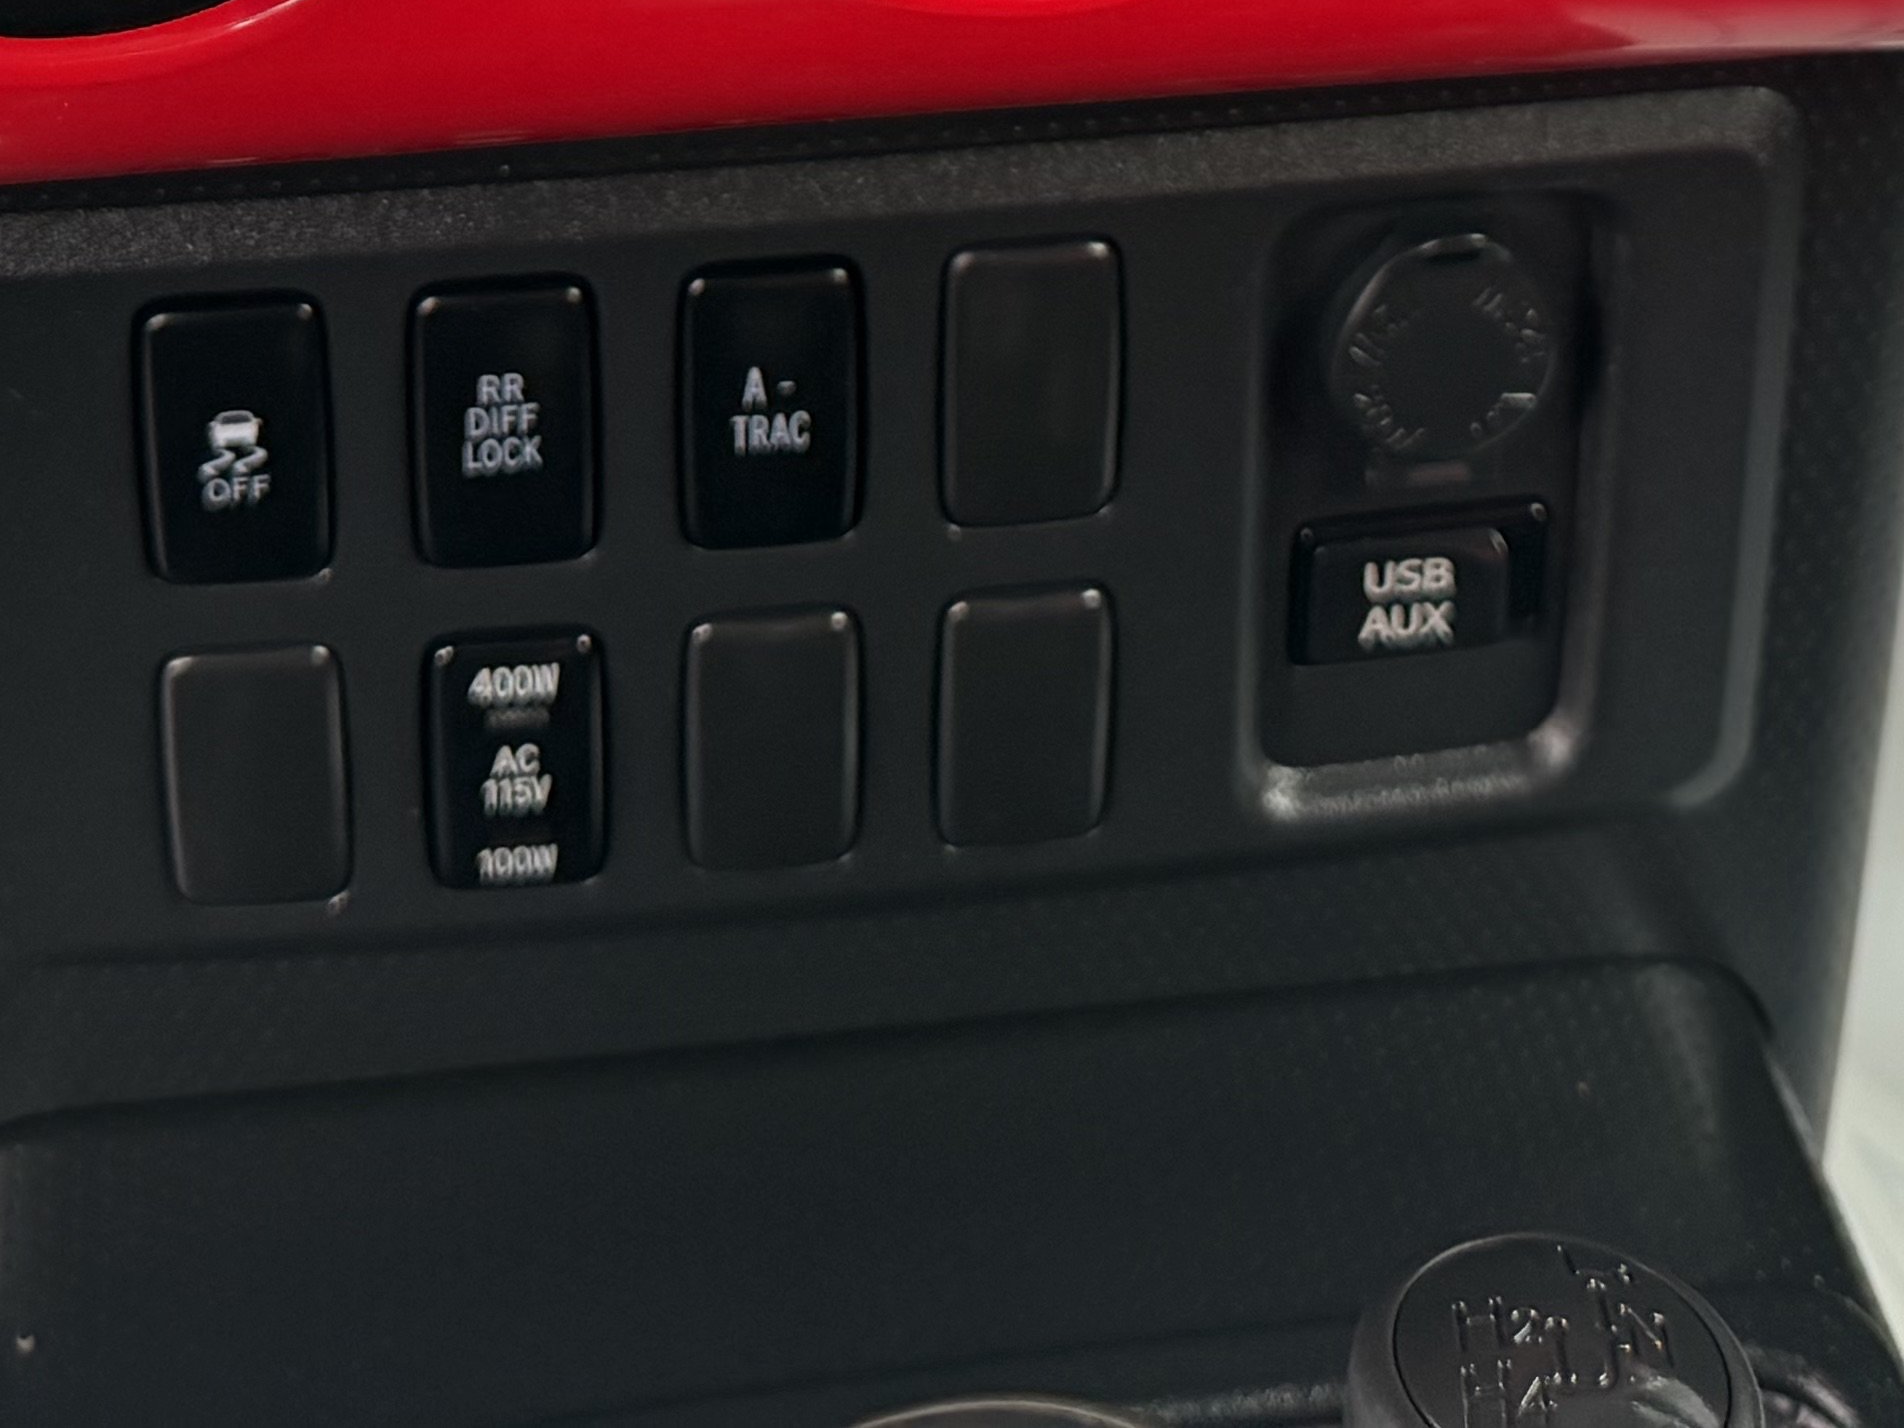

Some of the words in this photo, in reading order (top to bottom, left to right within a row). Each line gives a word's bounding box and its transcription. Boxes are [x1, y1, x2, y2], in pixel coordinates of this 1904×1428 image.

[479, 372, 525, 405] RR
[466, 402, 540, 438] DIFF
[729, 409, 812, 455] TRAC
[463, 436, 543, 475] LOCK
[201, 473, 270, 507] OFF
[1362, 556, 1456, 599] USB
[1358, 600, 1455, 647] AUX
[467, 662, 560, 707] 400W
[490, 743, 541, 777] AC
[481, 774, 553, 816] 115V
[477, 843, 559, 884] 100W
